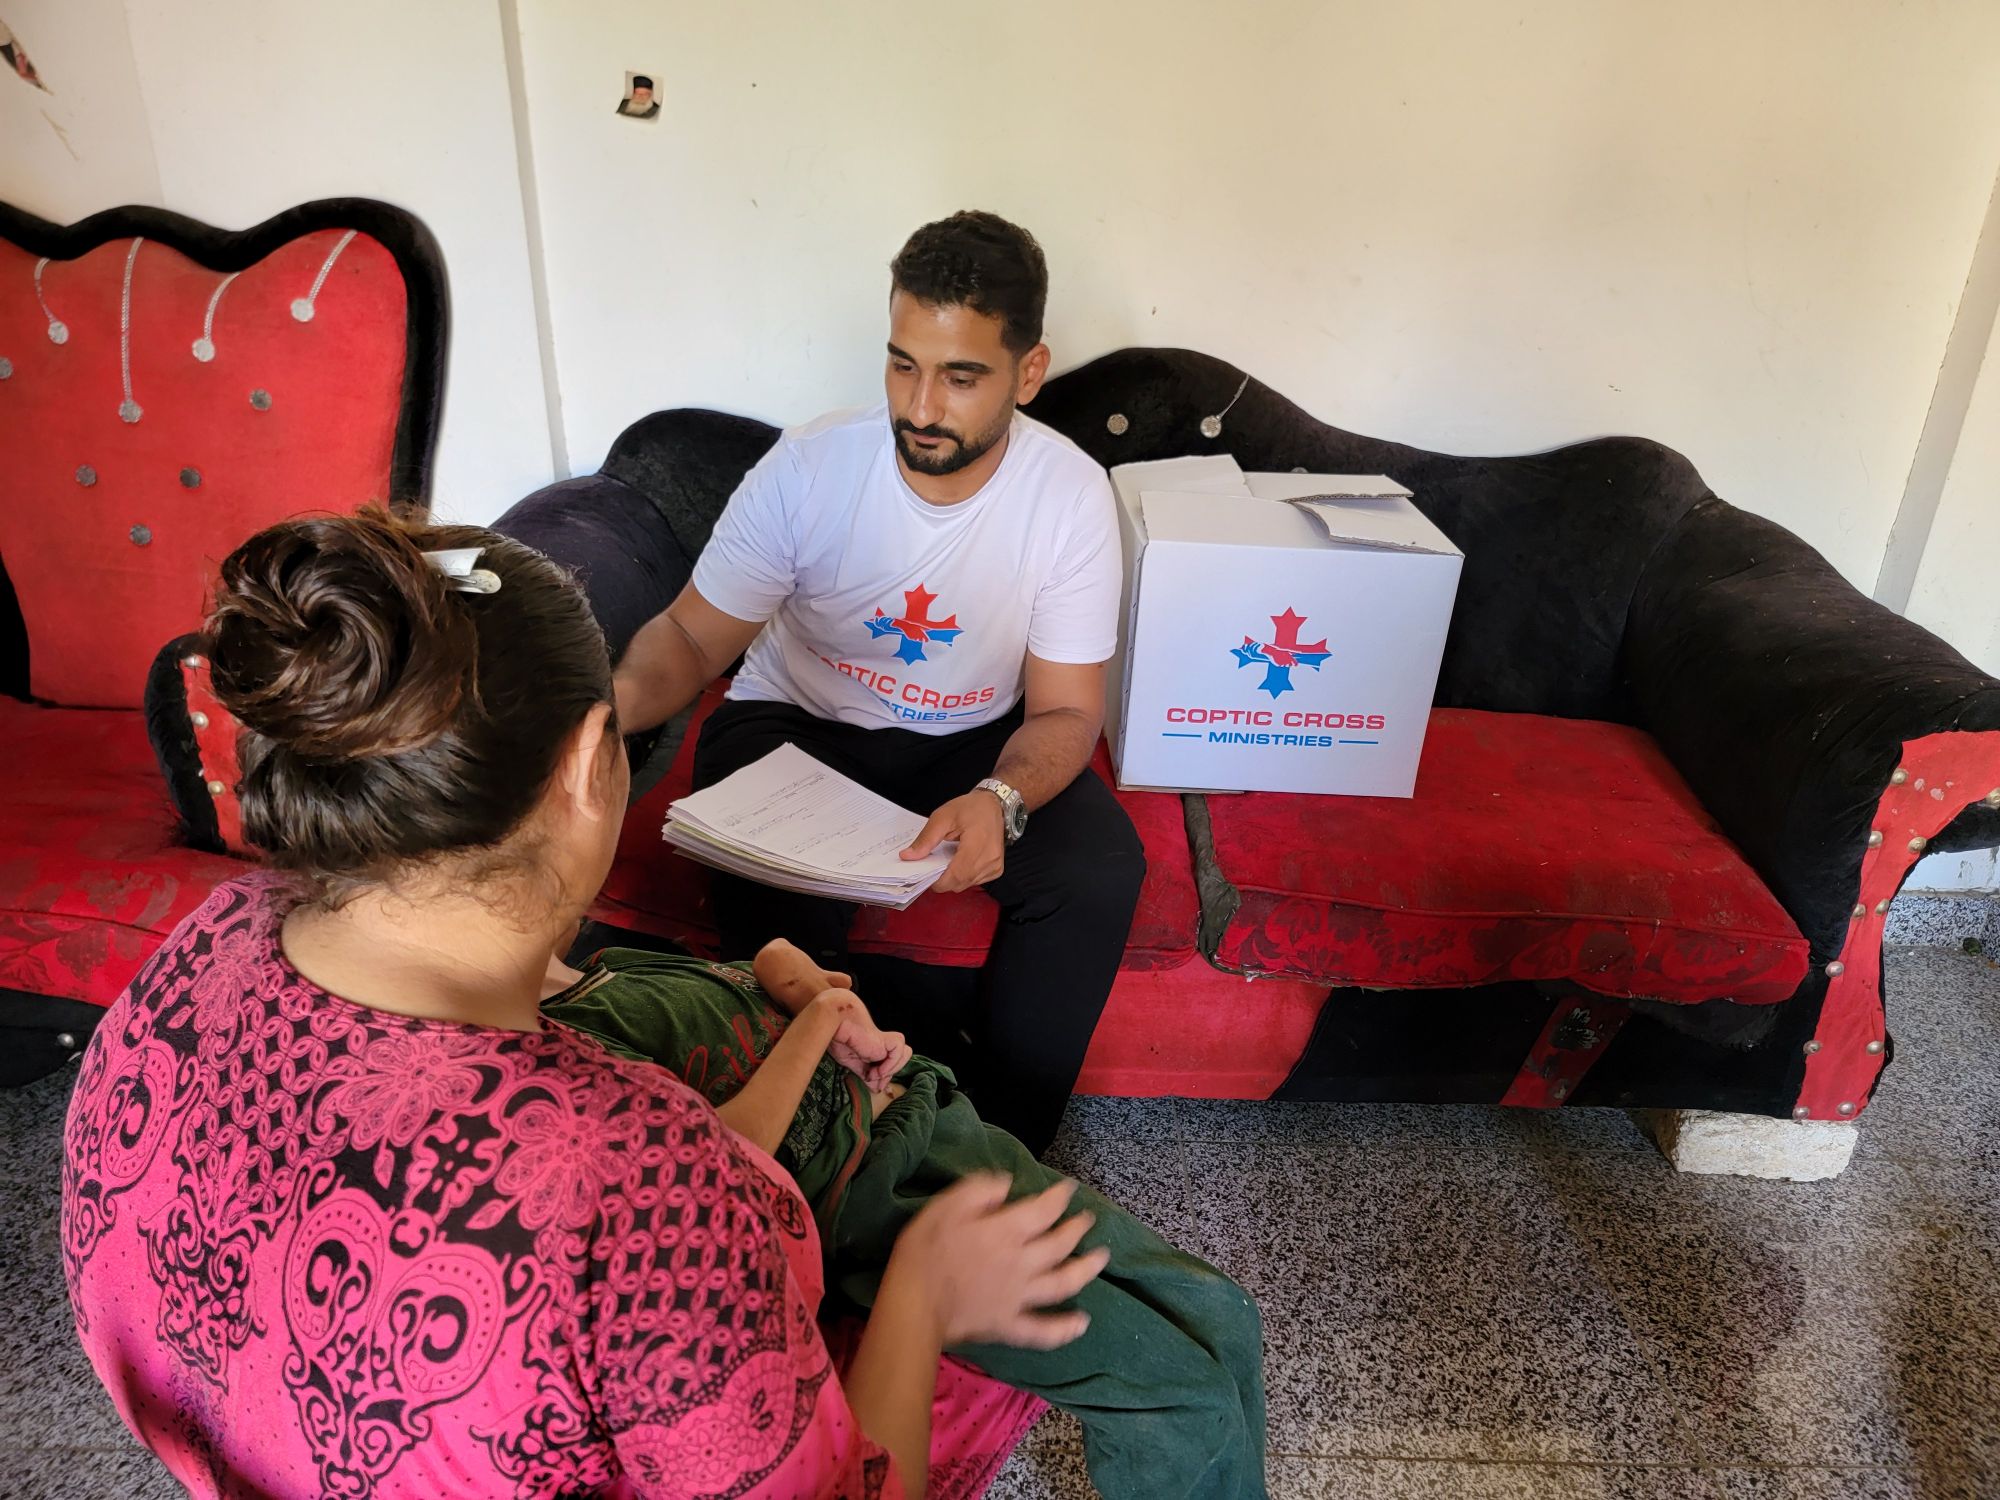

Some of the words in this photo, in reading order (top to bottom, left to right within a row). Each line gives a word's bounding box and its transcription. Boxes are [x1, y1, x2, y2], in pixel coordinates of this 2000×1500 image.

[807, 646, 897, 695] PTIC
[901, 683, 995, 709] CROSS
[1166, 707, 1273, 726] COPTIC
[1283, 712, 1386, 730] CROSS
[1208, 731, 1332, 747] MINISTRIES
